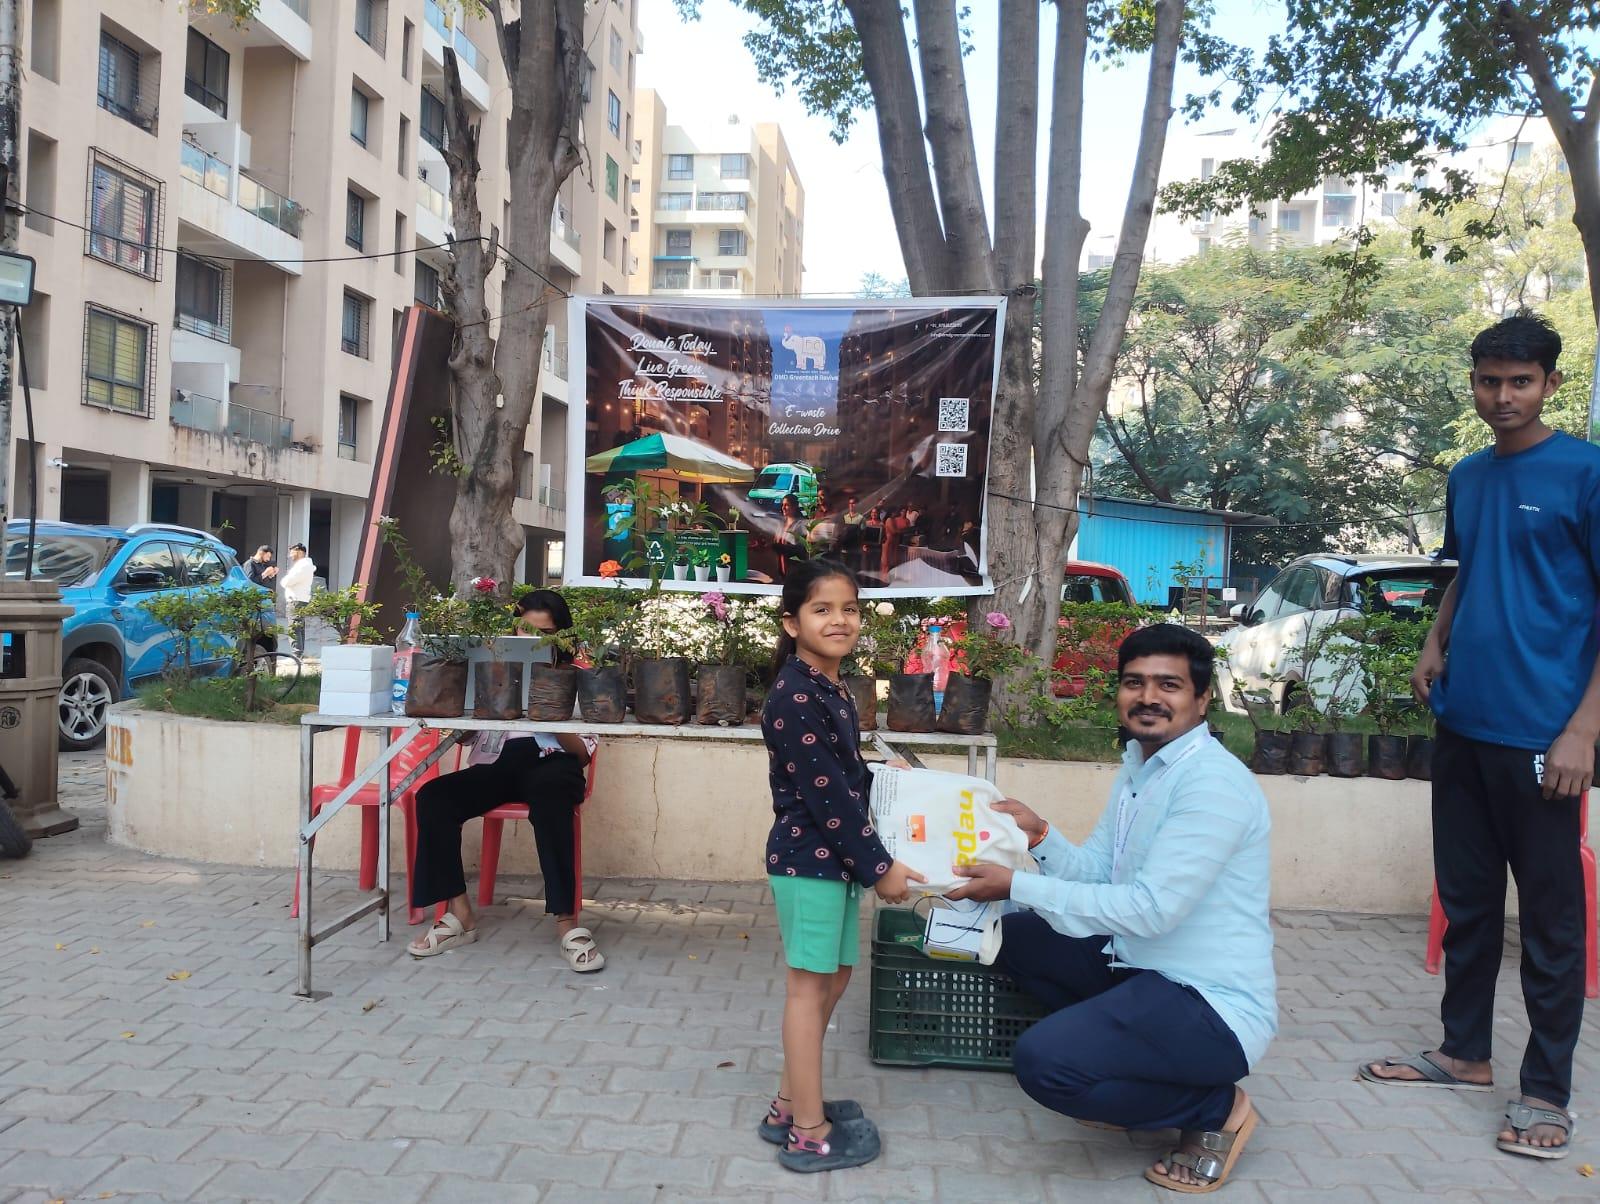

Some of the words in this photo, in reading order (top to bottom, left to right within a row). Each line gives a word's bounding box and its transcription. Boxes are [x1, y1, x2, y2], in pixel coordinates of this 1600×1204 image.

[629, 333, 676, 350] Donate
[678, 333, 715, 356] Today.
[635, 356, 664, 375] Live
[666, 359, 705, 378] Green.
[618, 379, 653, 397] Think
[655, 381, 724, 400] Responsible.
[768, 422, 812, 435] Collection
[813, 423, 842, 437] Drive
